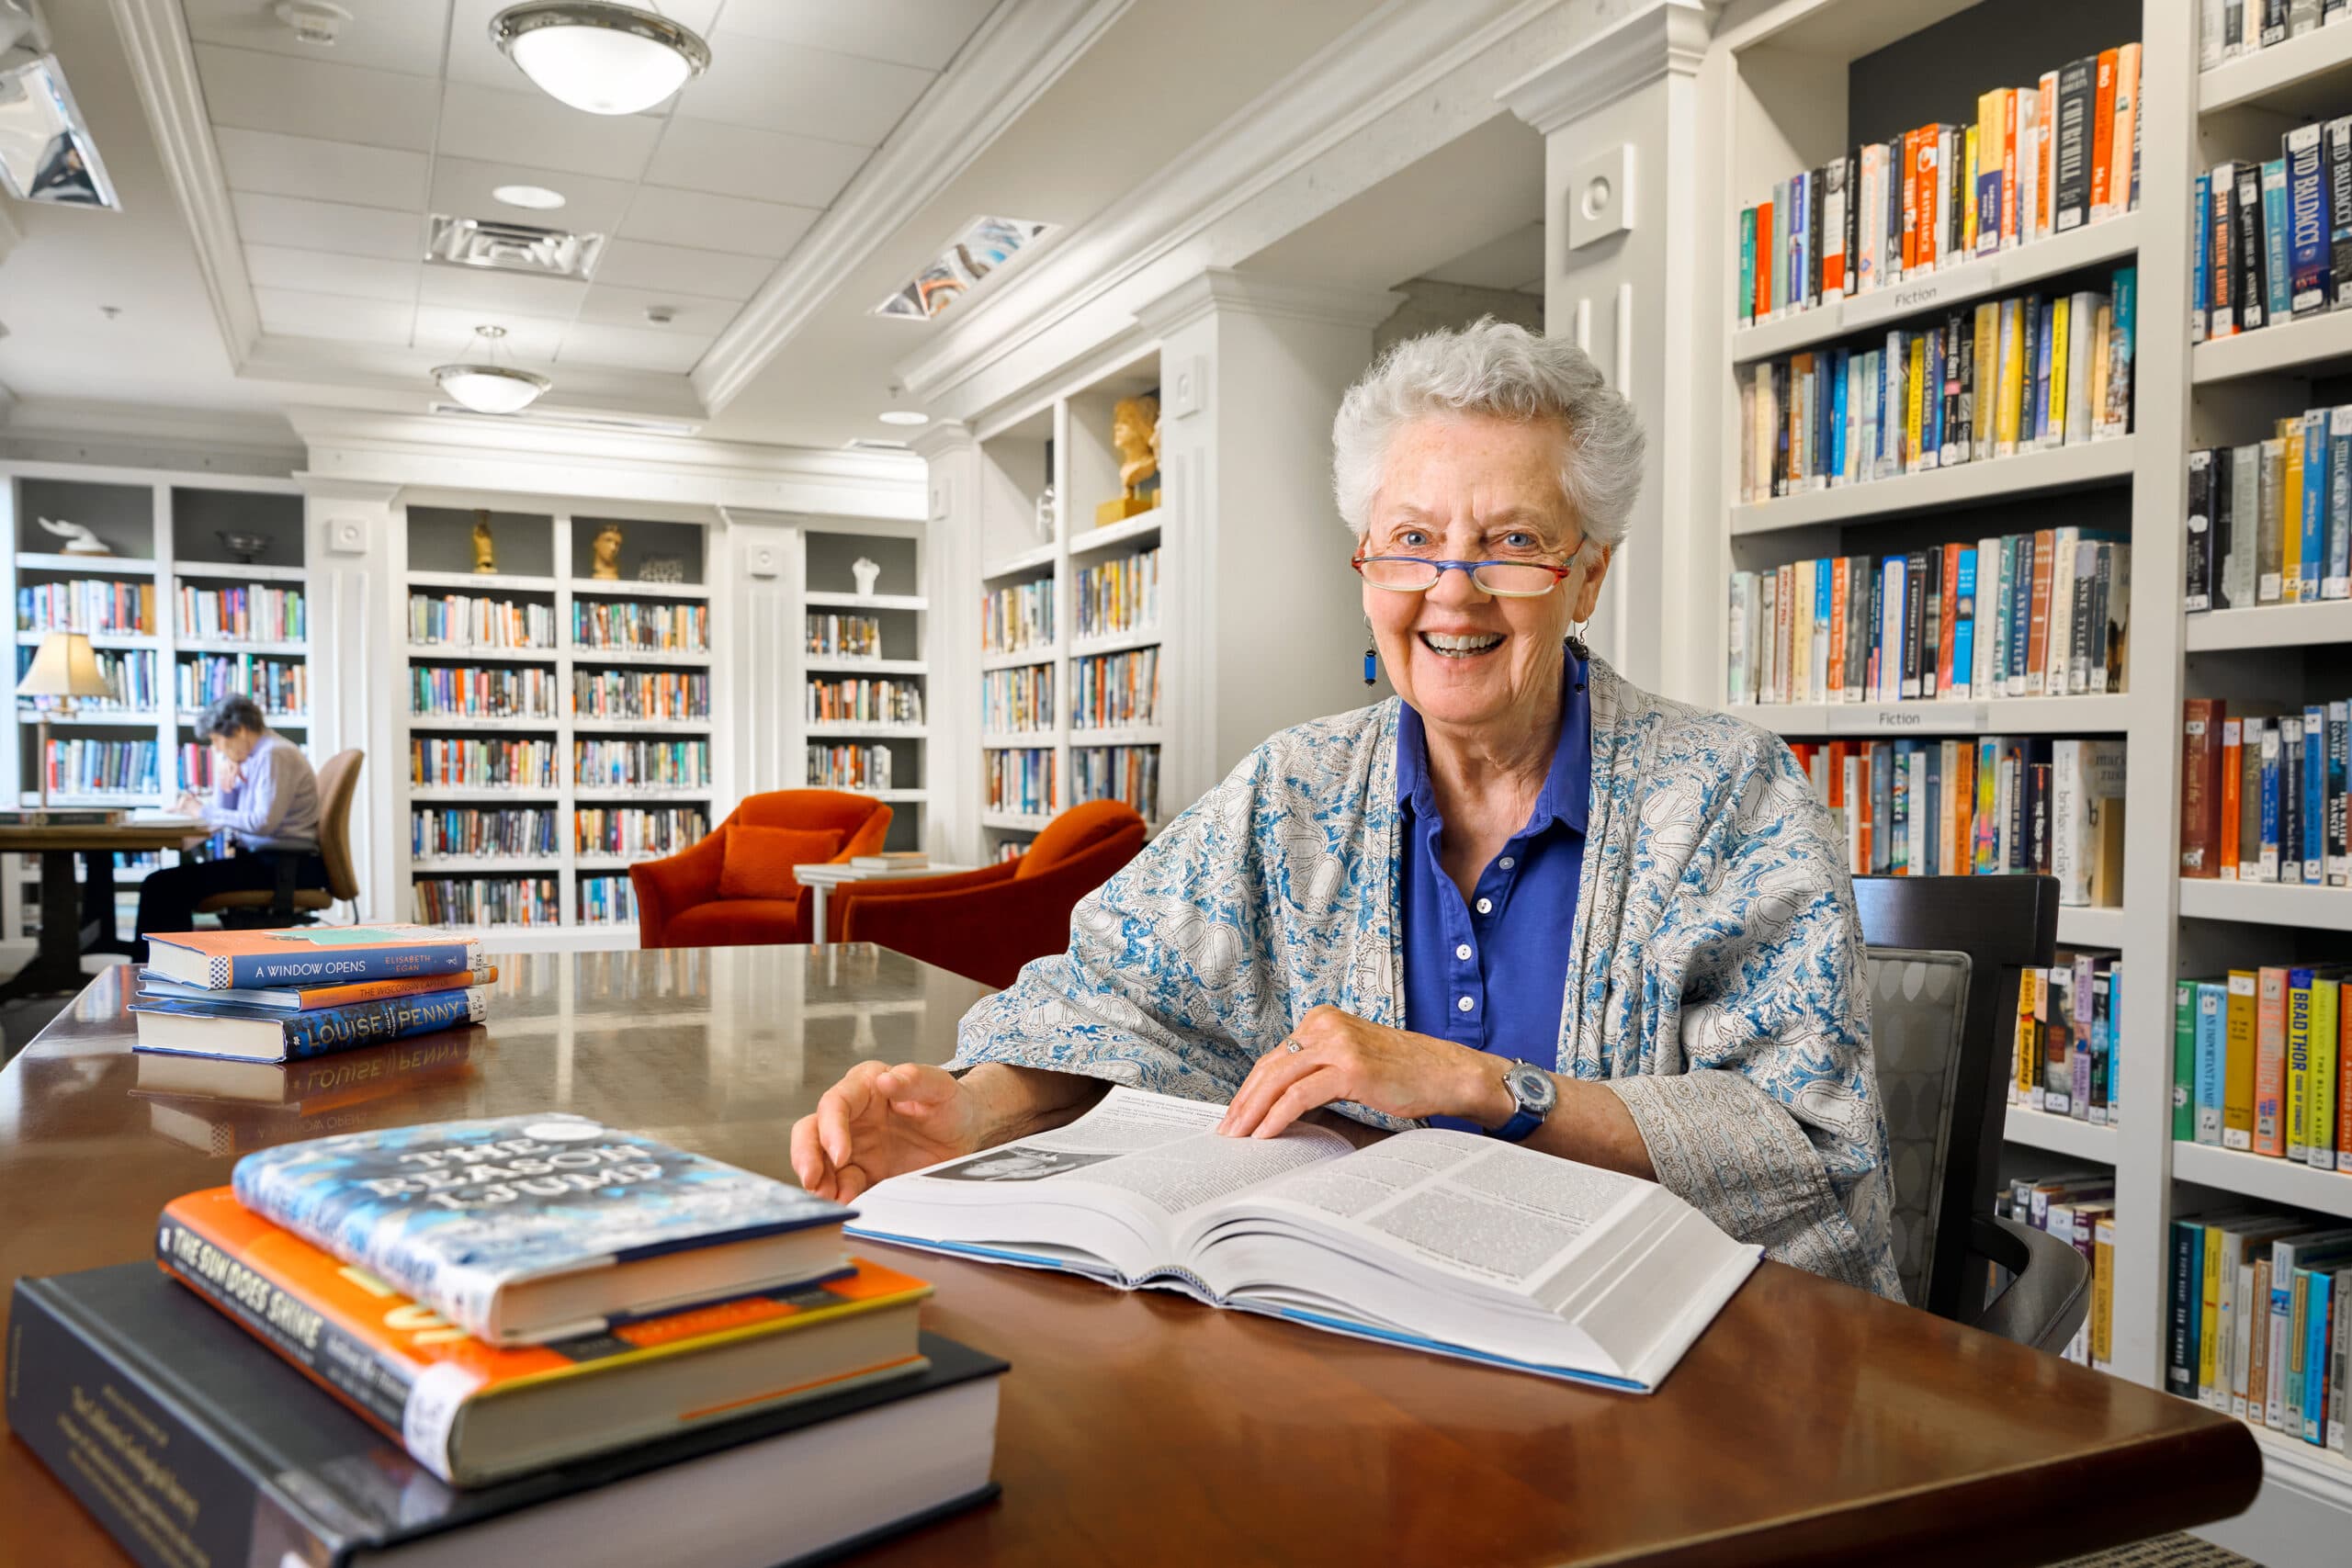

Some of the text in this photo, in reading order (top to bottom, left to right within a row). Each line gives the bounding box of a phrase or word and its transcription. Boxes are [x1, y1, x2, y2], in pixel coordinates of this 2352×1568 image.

[2294, 174, 2321, 248] BALDACCI
[2333, 162, 2352, 226] BALDACCI
[1894, 286, 1937, 309] Fiction
[1925, 332, 1936, 389] NICHOLAS
[2015, 592, 2027, 627] ANNE
[2077, 577, 2088, 611] ANNE
[1879, 712, 1920, 727] Fiction
[2330, 722, 2341, 760] COATES
[2329, 798, 2340, 838] DANCER
[255, 960, 366, 978] A WINDOW OPENS
[385, 955, 431, 964] ELISABETH
[396, 964, 421, 973] EGAN
[360, 988, 376, 998] THE
[378, 980, 420, 996] WISCONSIN
[307, 1014, 383, 1048] LOUISE
[398, 1000, 461, 1030] PENNY
[2292, 991, 2309, 1030] BRAD
[2291, 1033, 2308, 1072] THOR
[2318, 1055, 2326, 1076] THE
[2316, 1078, 2325, 1111] BLACK
[2344, 1071, 2352, 1111] DIVIDED
[2343, 1113, 2352, 1152] LOYALT
[368, 1145, 651, 1198] REASON
[399, 1138, 550, 1168] THE
[483, 1163, 662, 1203] JUMP
[172, 1227, 203, 1268] THE
[198, 1242, 229, 1285] SUN
[225, 1262, 270, 1314] DOES
[268, 1286, 324, 1348] SHINE
